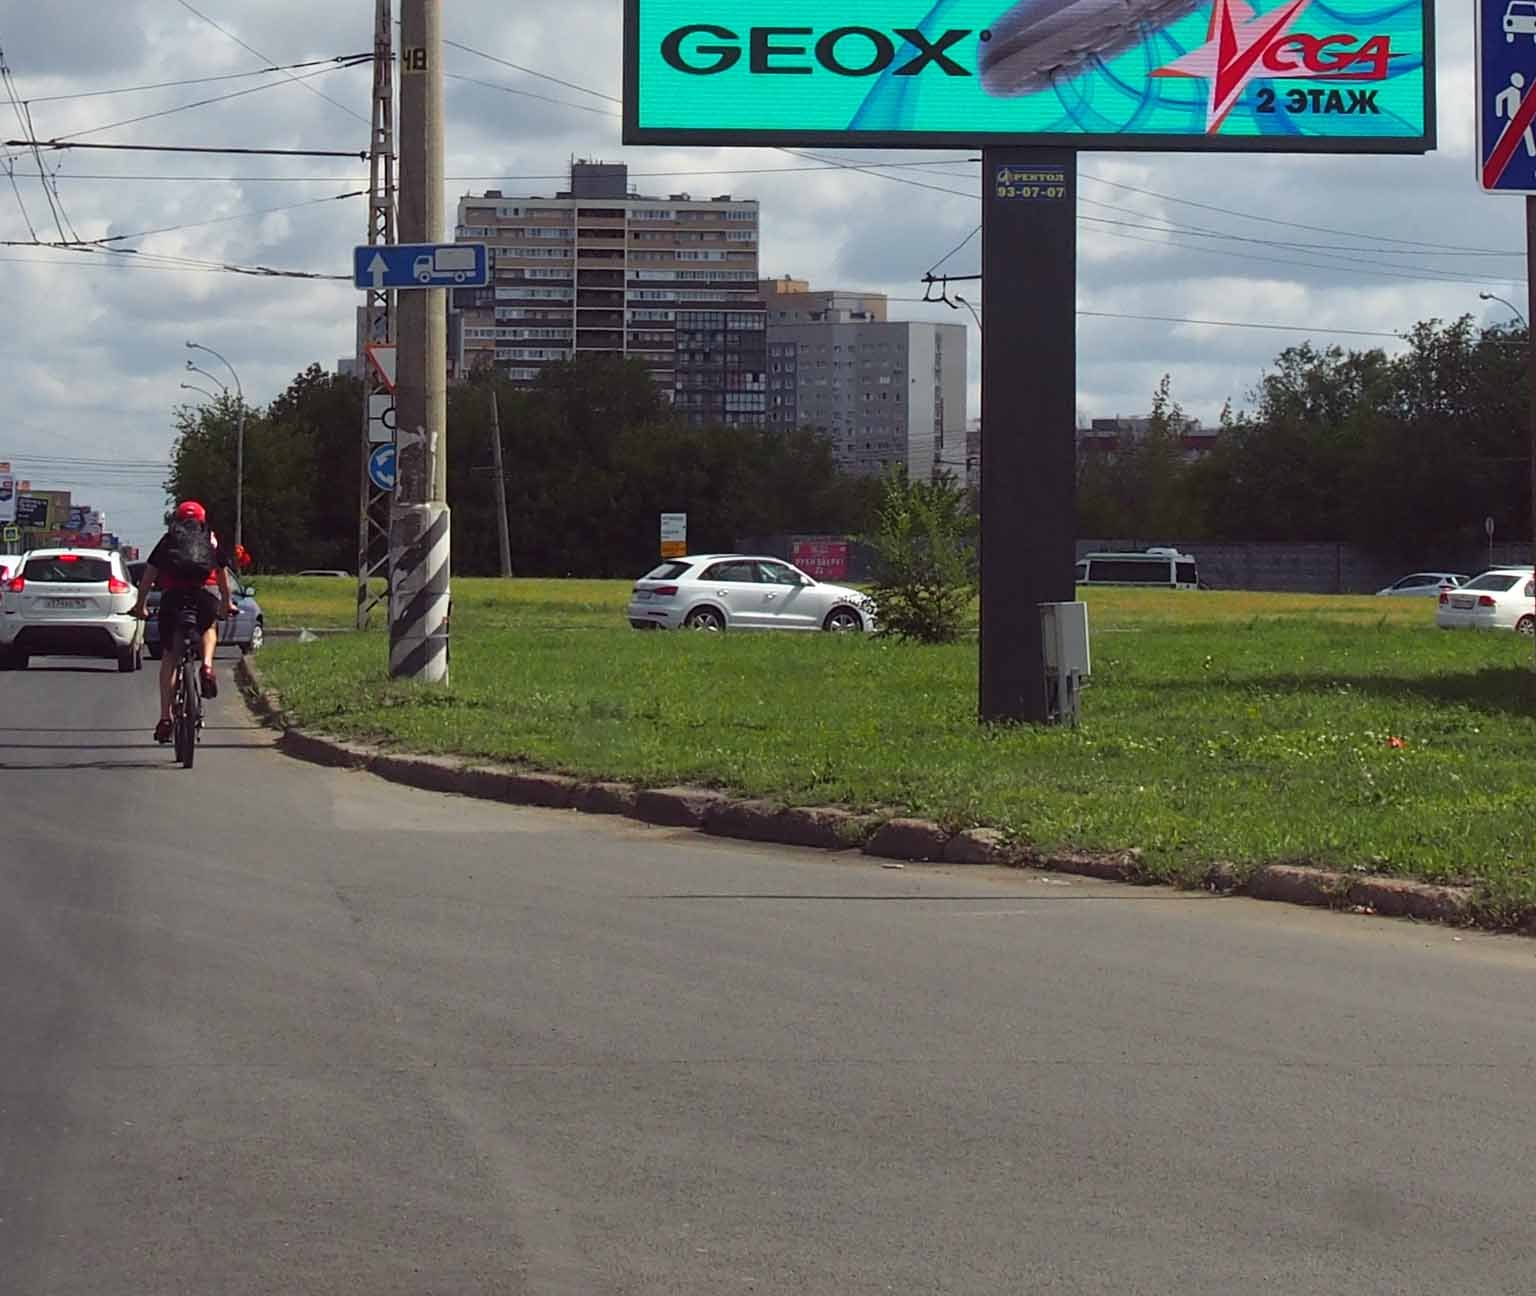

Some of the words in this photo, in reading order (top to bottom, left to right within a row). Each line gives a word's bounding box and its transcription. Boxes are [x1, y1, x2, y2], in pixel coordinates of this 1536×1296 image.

[660, 24, 973, 76] GEOX
[1256, 88, 1276, 114] 2
[1286, 88, 1381, 115] ЭТАЖ
[997, 186, 1064, 198] 93-07-07
